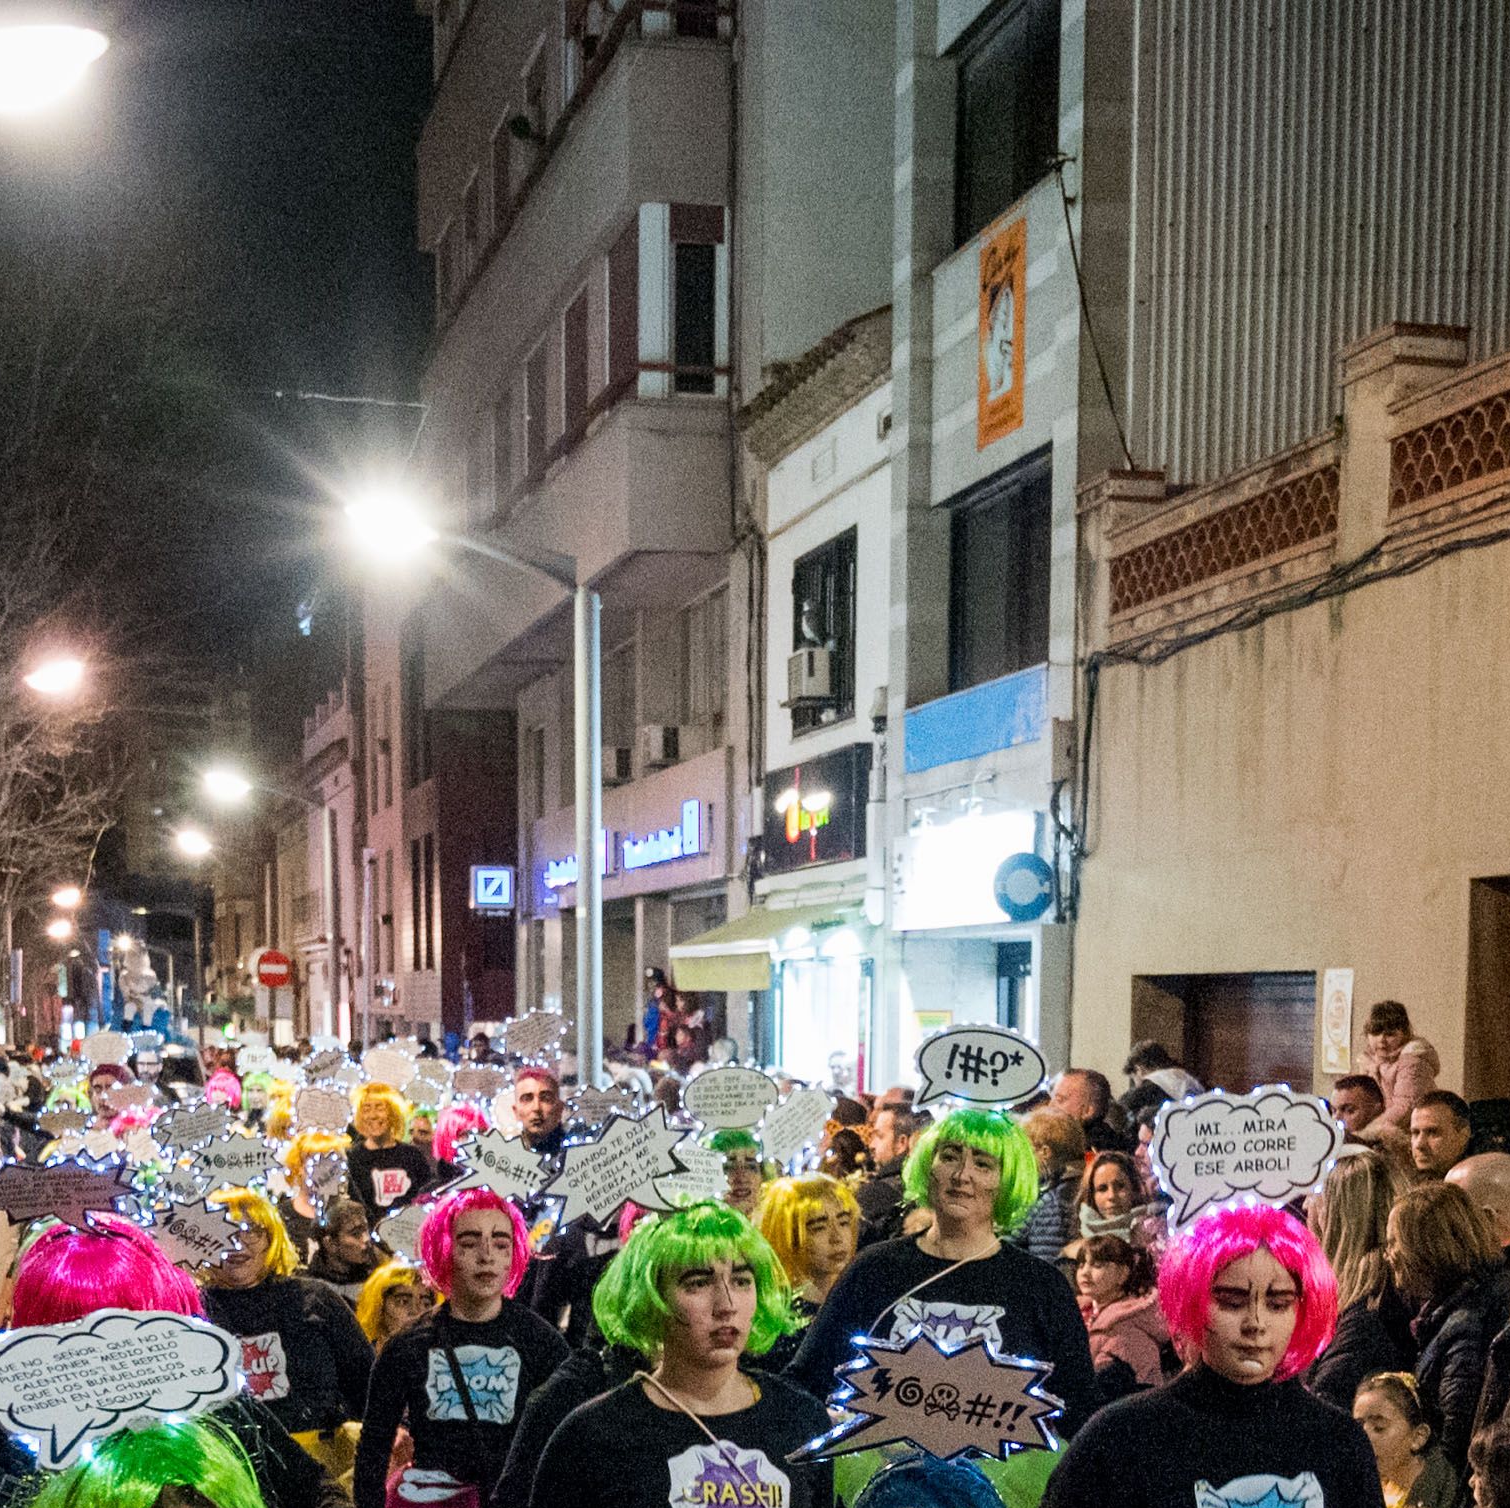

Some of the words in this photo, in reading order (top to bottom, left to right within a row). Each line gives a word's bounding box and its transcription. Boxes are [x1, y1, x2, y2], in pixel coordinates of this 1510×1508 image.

[610, 1134, 624, 1149] TE
[625, 1119, 652, 1140] DIJE
[1186, 1138, 1237, 1157] CÓMO
[1243, 1136, 1297, 1154] CORRE
[583, 1179, 598, 1193] LA
[635, 1145, 650, 1161] ME
[630, 1167, 640, 1178] A
[640, 1156, 659, 1174] LAS
[1194, 1161, 1225, 1176] ESE
[568, 1172, 590, 1190] QUE
[106, 1339, 135, 1350] QUE
[137, 1334, 159, 1345] NO
[161, 1329, 179, 1340] LE
[46, 1358, 91, 1374] PONER
[147, 1340, 178, 1354] KILO
[131, 1351, 179, 1367] REPITO
[22, 1388, 51, 1402] QUE
[55, 1382, 84, 1395] LOS
[157, 1361, 186, 1372] LOS
[70, 1391, 91, 1403] EN
[93, 1387, 111, 1398] LA
[190, 1366, 210, 1377] DE
